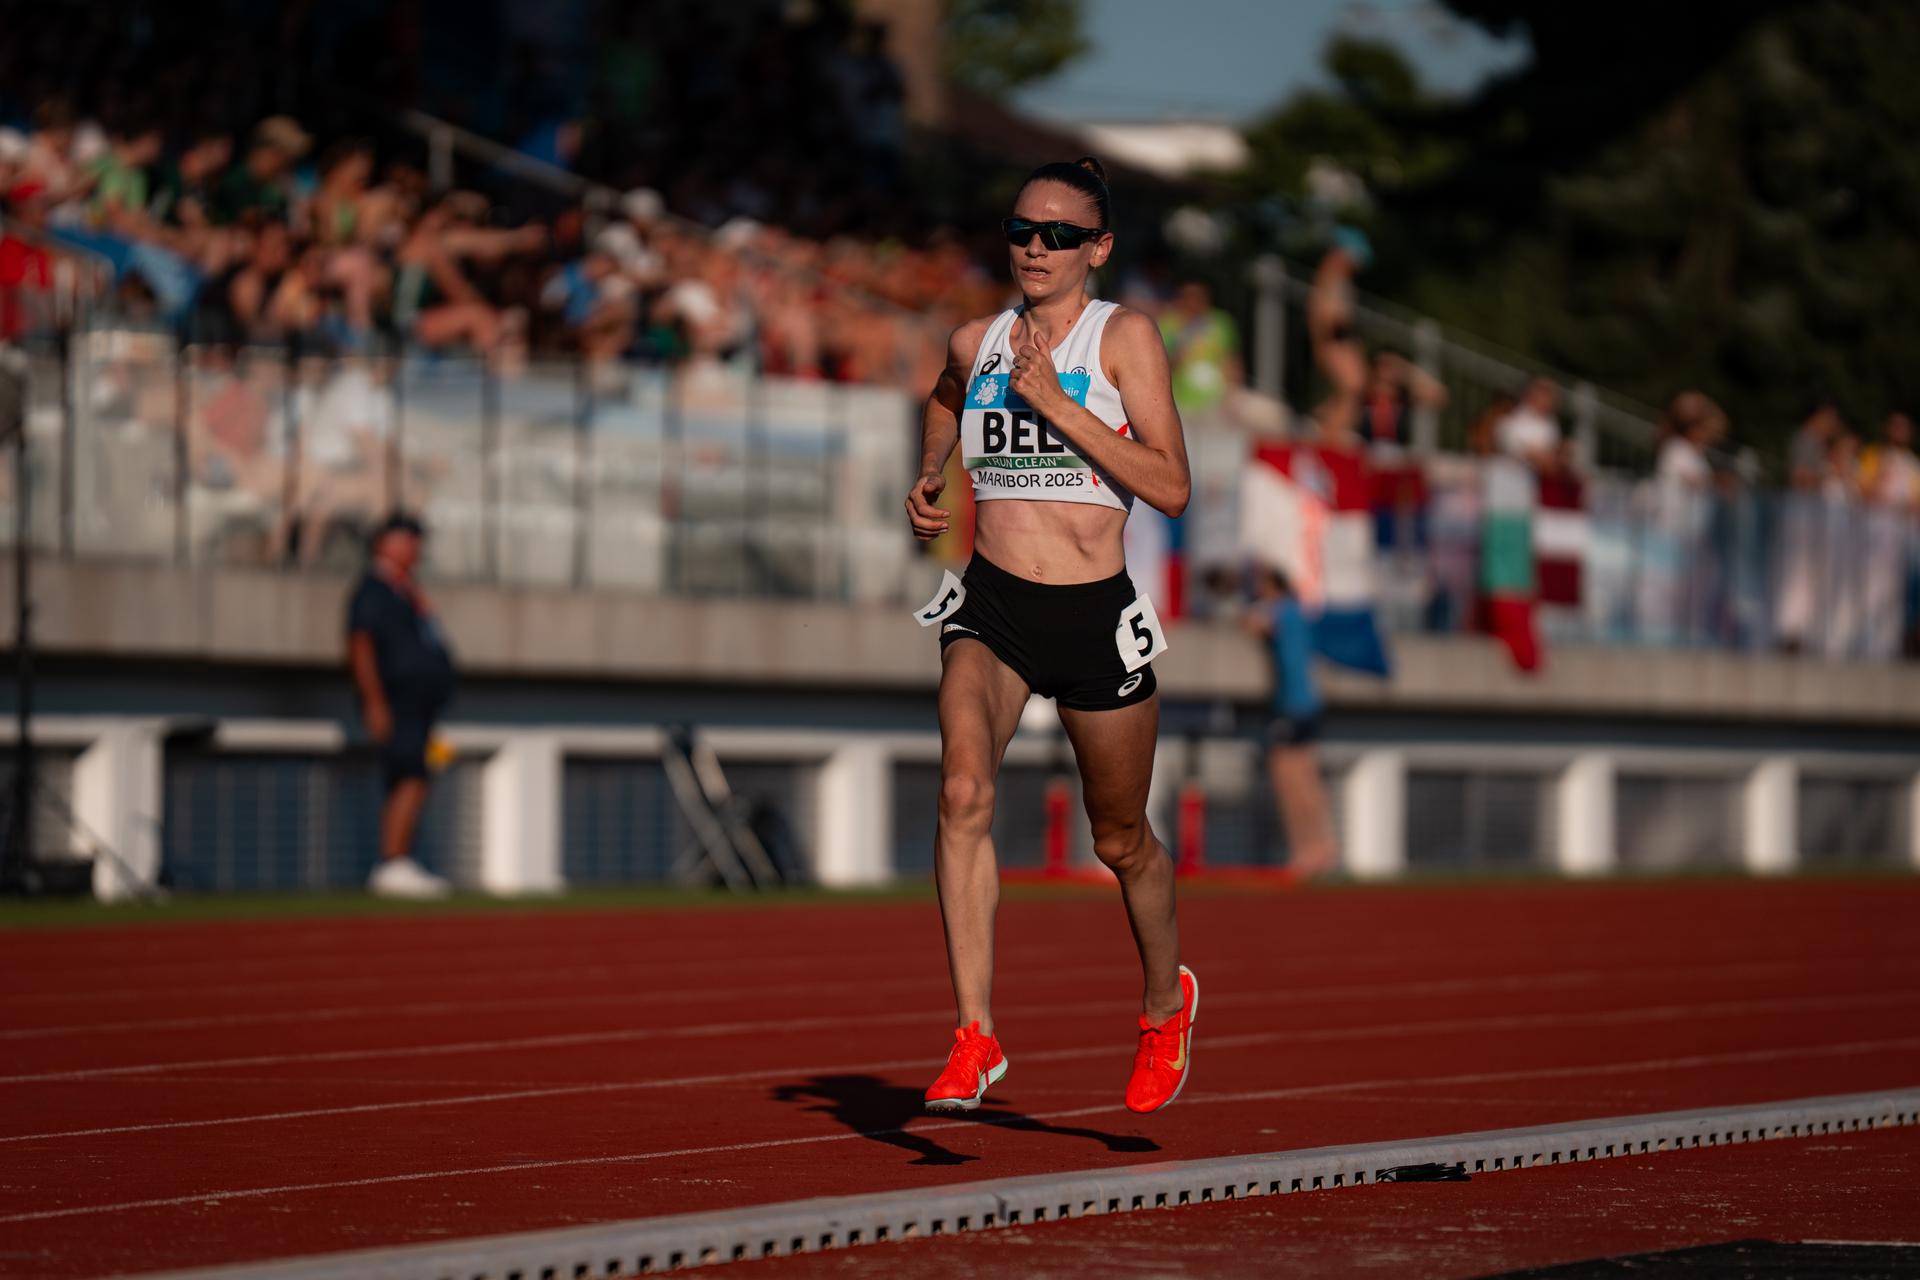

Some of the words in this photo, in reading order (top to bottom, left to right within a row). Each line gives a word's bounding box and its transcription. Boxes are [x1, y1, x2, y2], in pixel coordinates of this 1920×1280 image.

[983, 411, 1065, 454] BEL
[977, 470, 1041, 488] MARIBOR
[1044, 472, 1084, 487] 2025
[993, 457, 1013, 468] RUN
[922, 587, 958, 620] 5
[1129, 611, 1154, 658] 5
